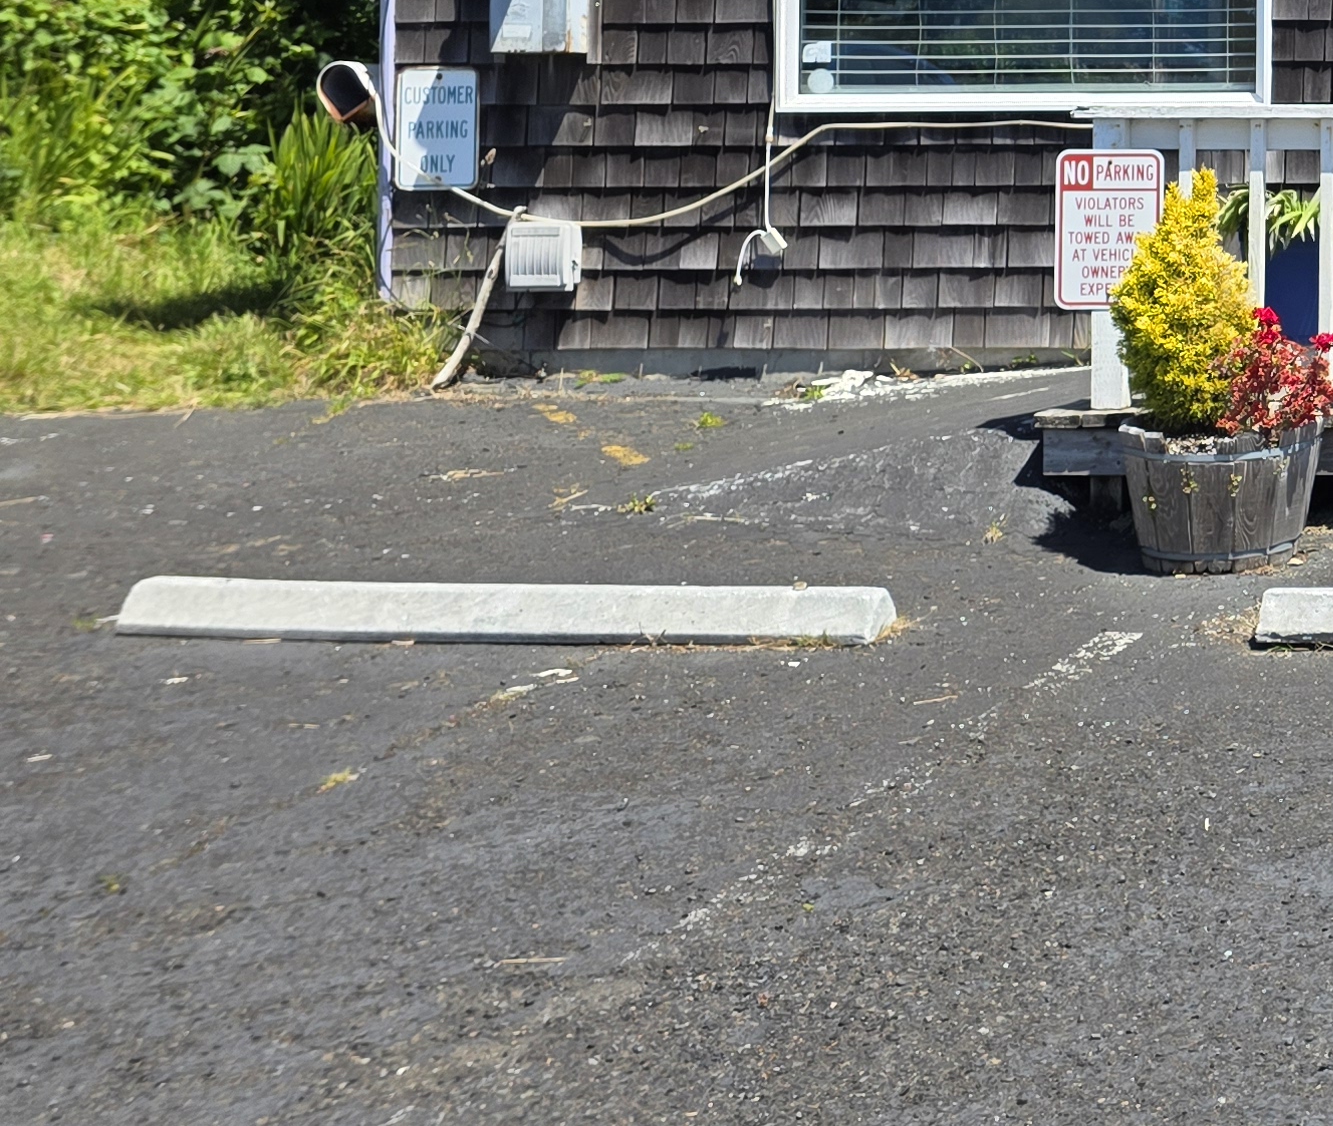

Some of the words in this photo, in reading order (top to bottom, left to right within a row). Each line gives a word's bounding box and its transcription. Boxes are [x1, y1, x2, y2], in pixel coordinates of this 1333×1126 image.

[404, 85, 474, 105] CUSTOMER
[407, 119, 469, 140] PARKING
[420, 154, 456, 173] ONLY
[1063, 160, 1089, 185] NO
[1095, 163, 1154, 181] PARKING
[1074, 196, 1144, 210] VIOLATORS
[1083, 214, 1112, 227] WILL
[1118, 214, 1135, 227] BE
[1067, 231, 1110, 244] TOWED
[1071, 248, 1086, 262] AT
